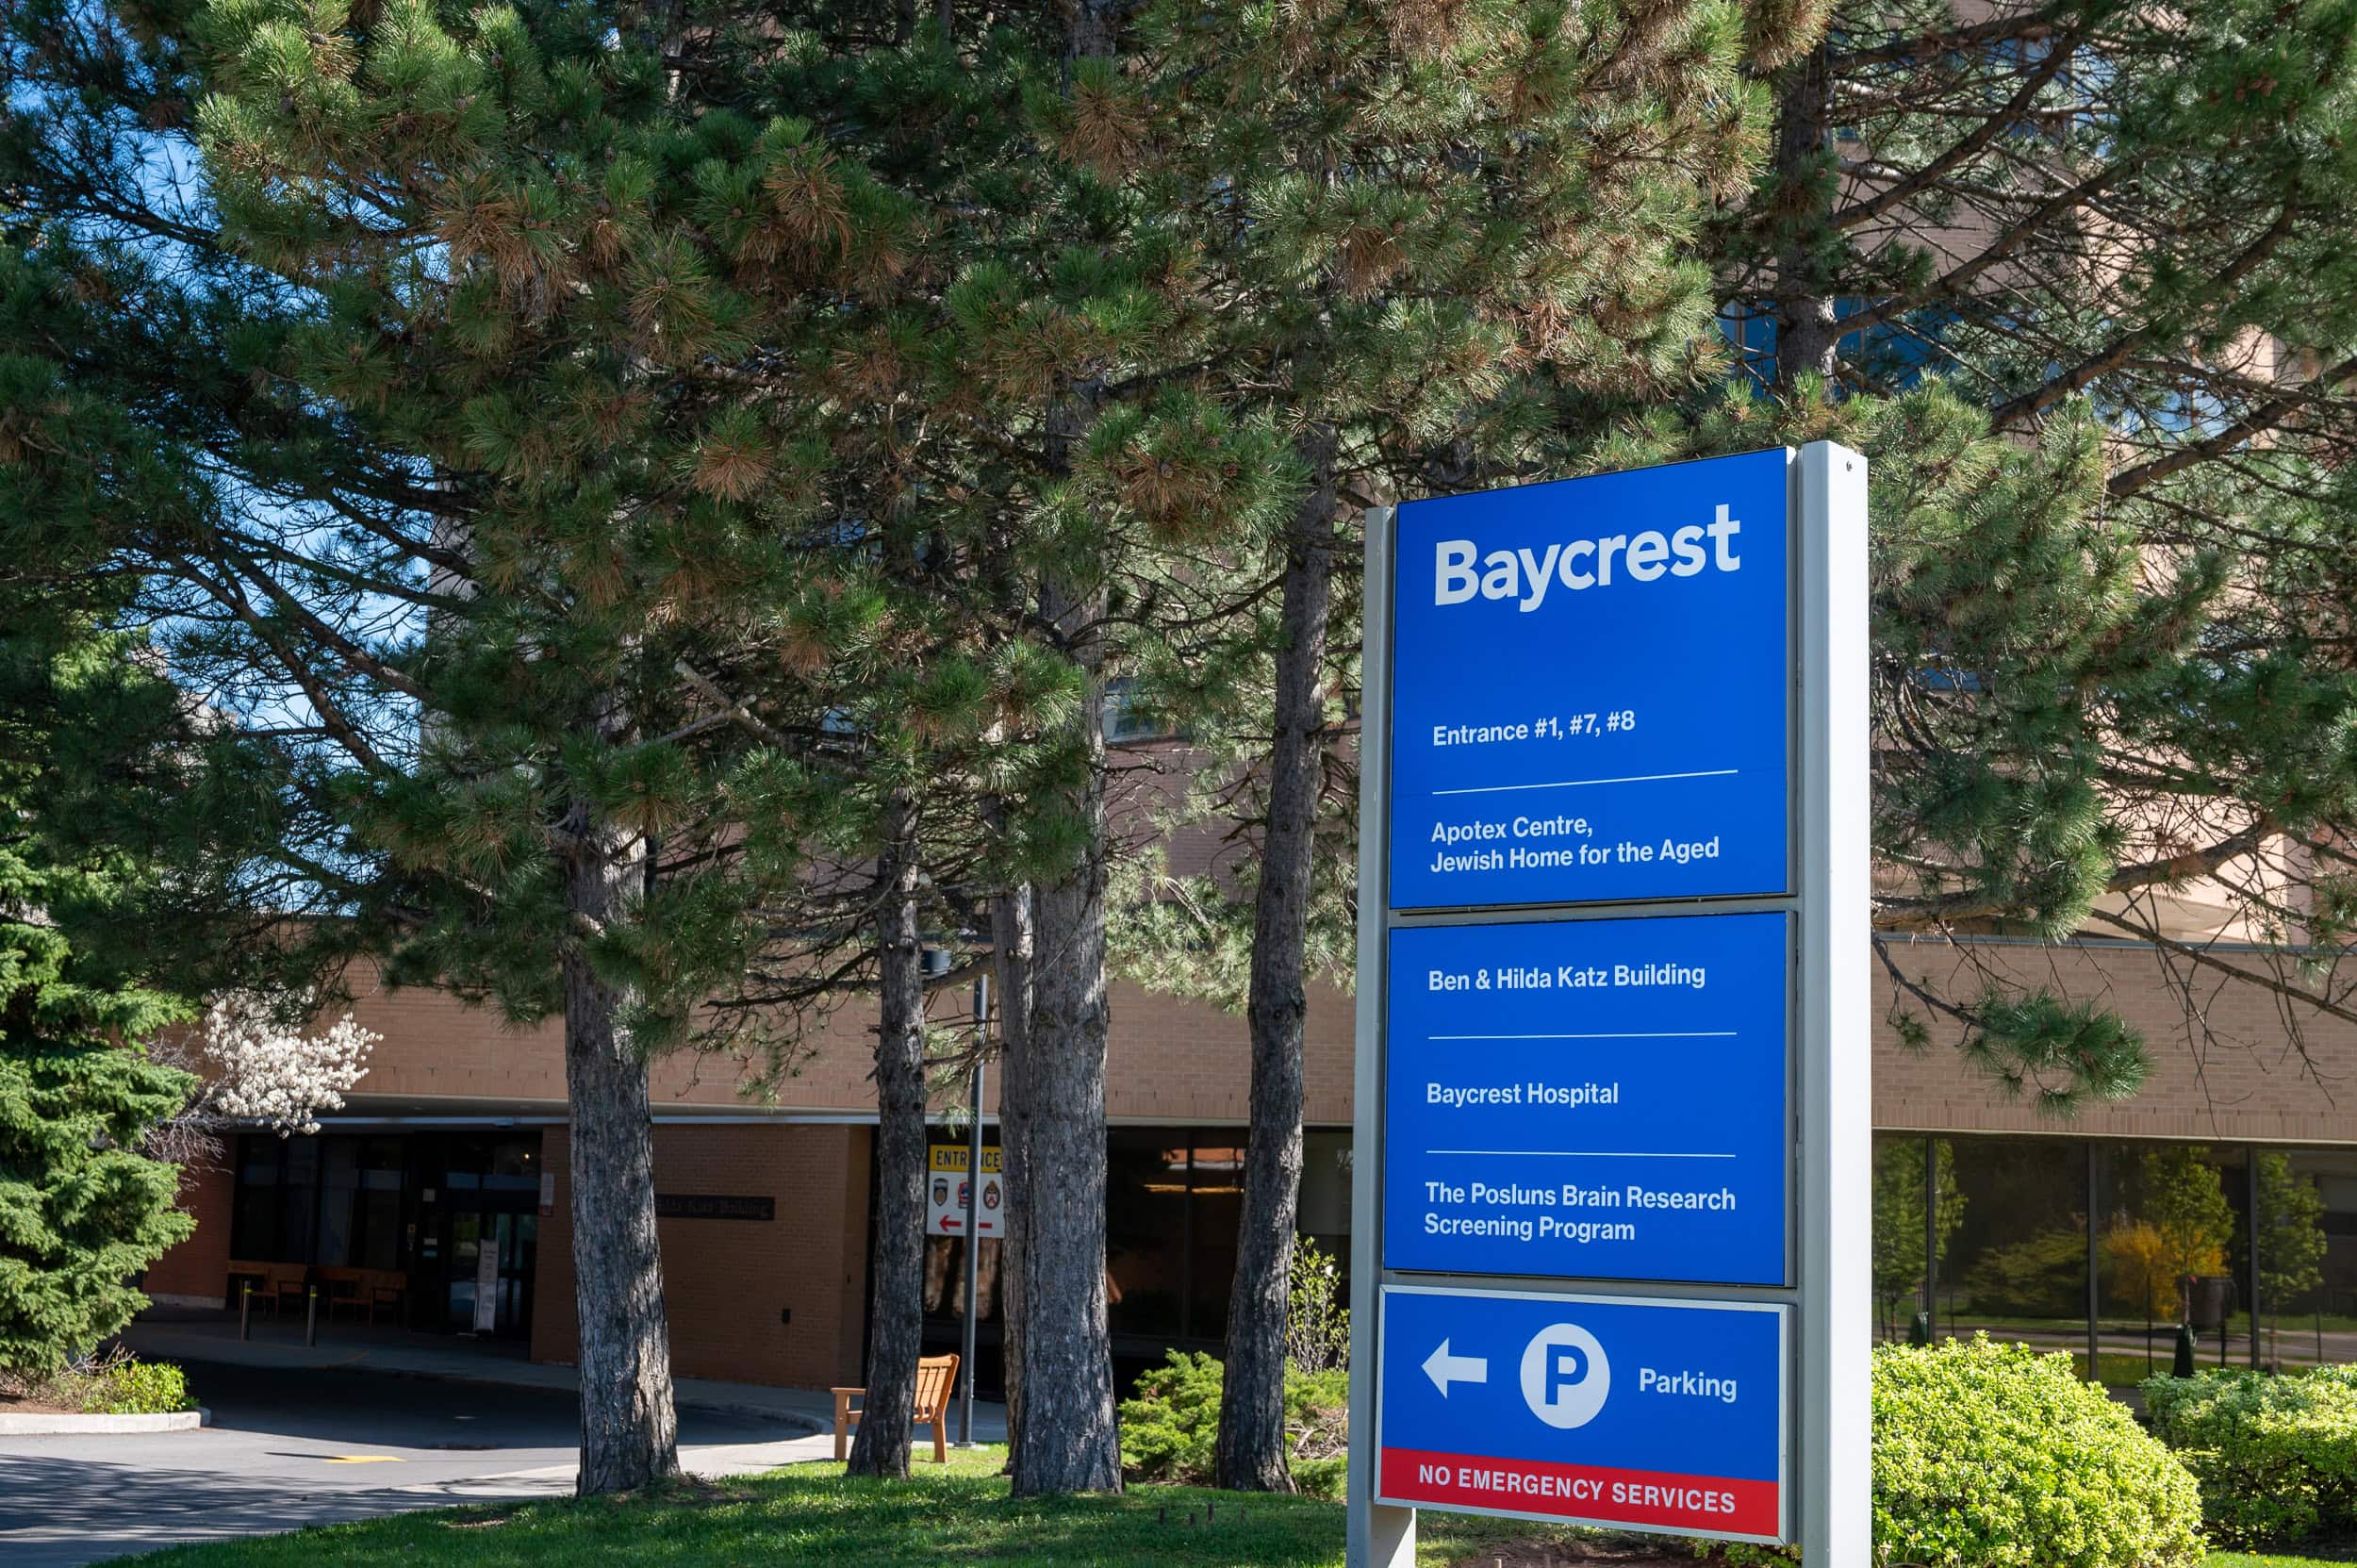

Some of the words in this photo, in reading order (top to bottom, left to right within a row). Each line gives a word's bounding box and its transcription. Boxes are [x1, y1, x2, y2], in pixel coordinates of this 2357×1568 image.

[1435, 504, 1740, 613] Baycrest
[1433, 723, 1529, 746] Entrance
[1534, 718, 1563, 740] #1,
[1569, 713, 1601, 737] #7,
[1607, 710, 1636, 732] #8
[1431, 821, 1507, 846] Apotex
[1512, 815, 1592, 838] Centre,
[1430, 850, 1504, 873] Jewish
[1509, 847, 1574, 868] Home
[1578, 844, 1611, 866] for
[1616, 841, 1654, 863] the
[1658, 835, 1720, 865] Aged
[1428, 970, 1470, 991] Ben
[1475, 968, 1492, 990] &
[1497, 967, 1552, 989] Hilda
[1558, 966, 1608, 988] Katz
[1614, 963, 1706, 989] Building
[1426, 1082, 1522, 1109] Baycrest
[1527, 1082, 1619, 1109] Hospital
[936, 1150, 1000, 1167] ENTRCE
[1425, 1181, 1465, 1204] The
[1471, 1182, 1557, 1206] Posluns
[1562, 1184, 1621, 1208] Brain
[1626, 1185, 1736, 1211] Research
[1425, 1213, 1533, 1242] Screening
[1539, 1215, 1636, 1244] Program
[1545, 1344, 1589, 1406] P
[1640, 1367, 1737, 1404] Parking
[1418, 1463, 1451, 1486] NO
[1458, 1467, 1605, 1501] EMERGENCY
[1611, 1481, 1736, 1514] SERVICES
